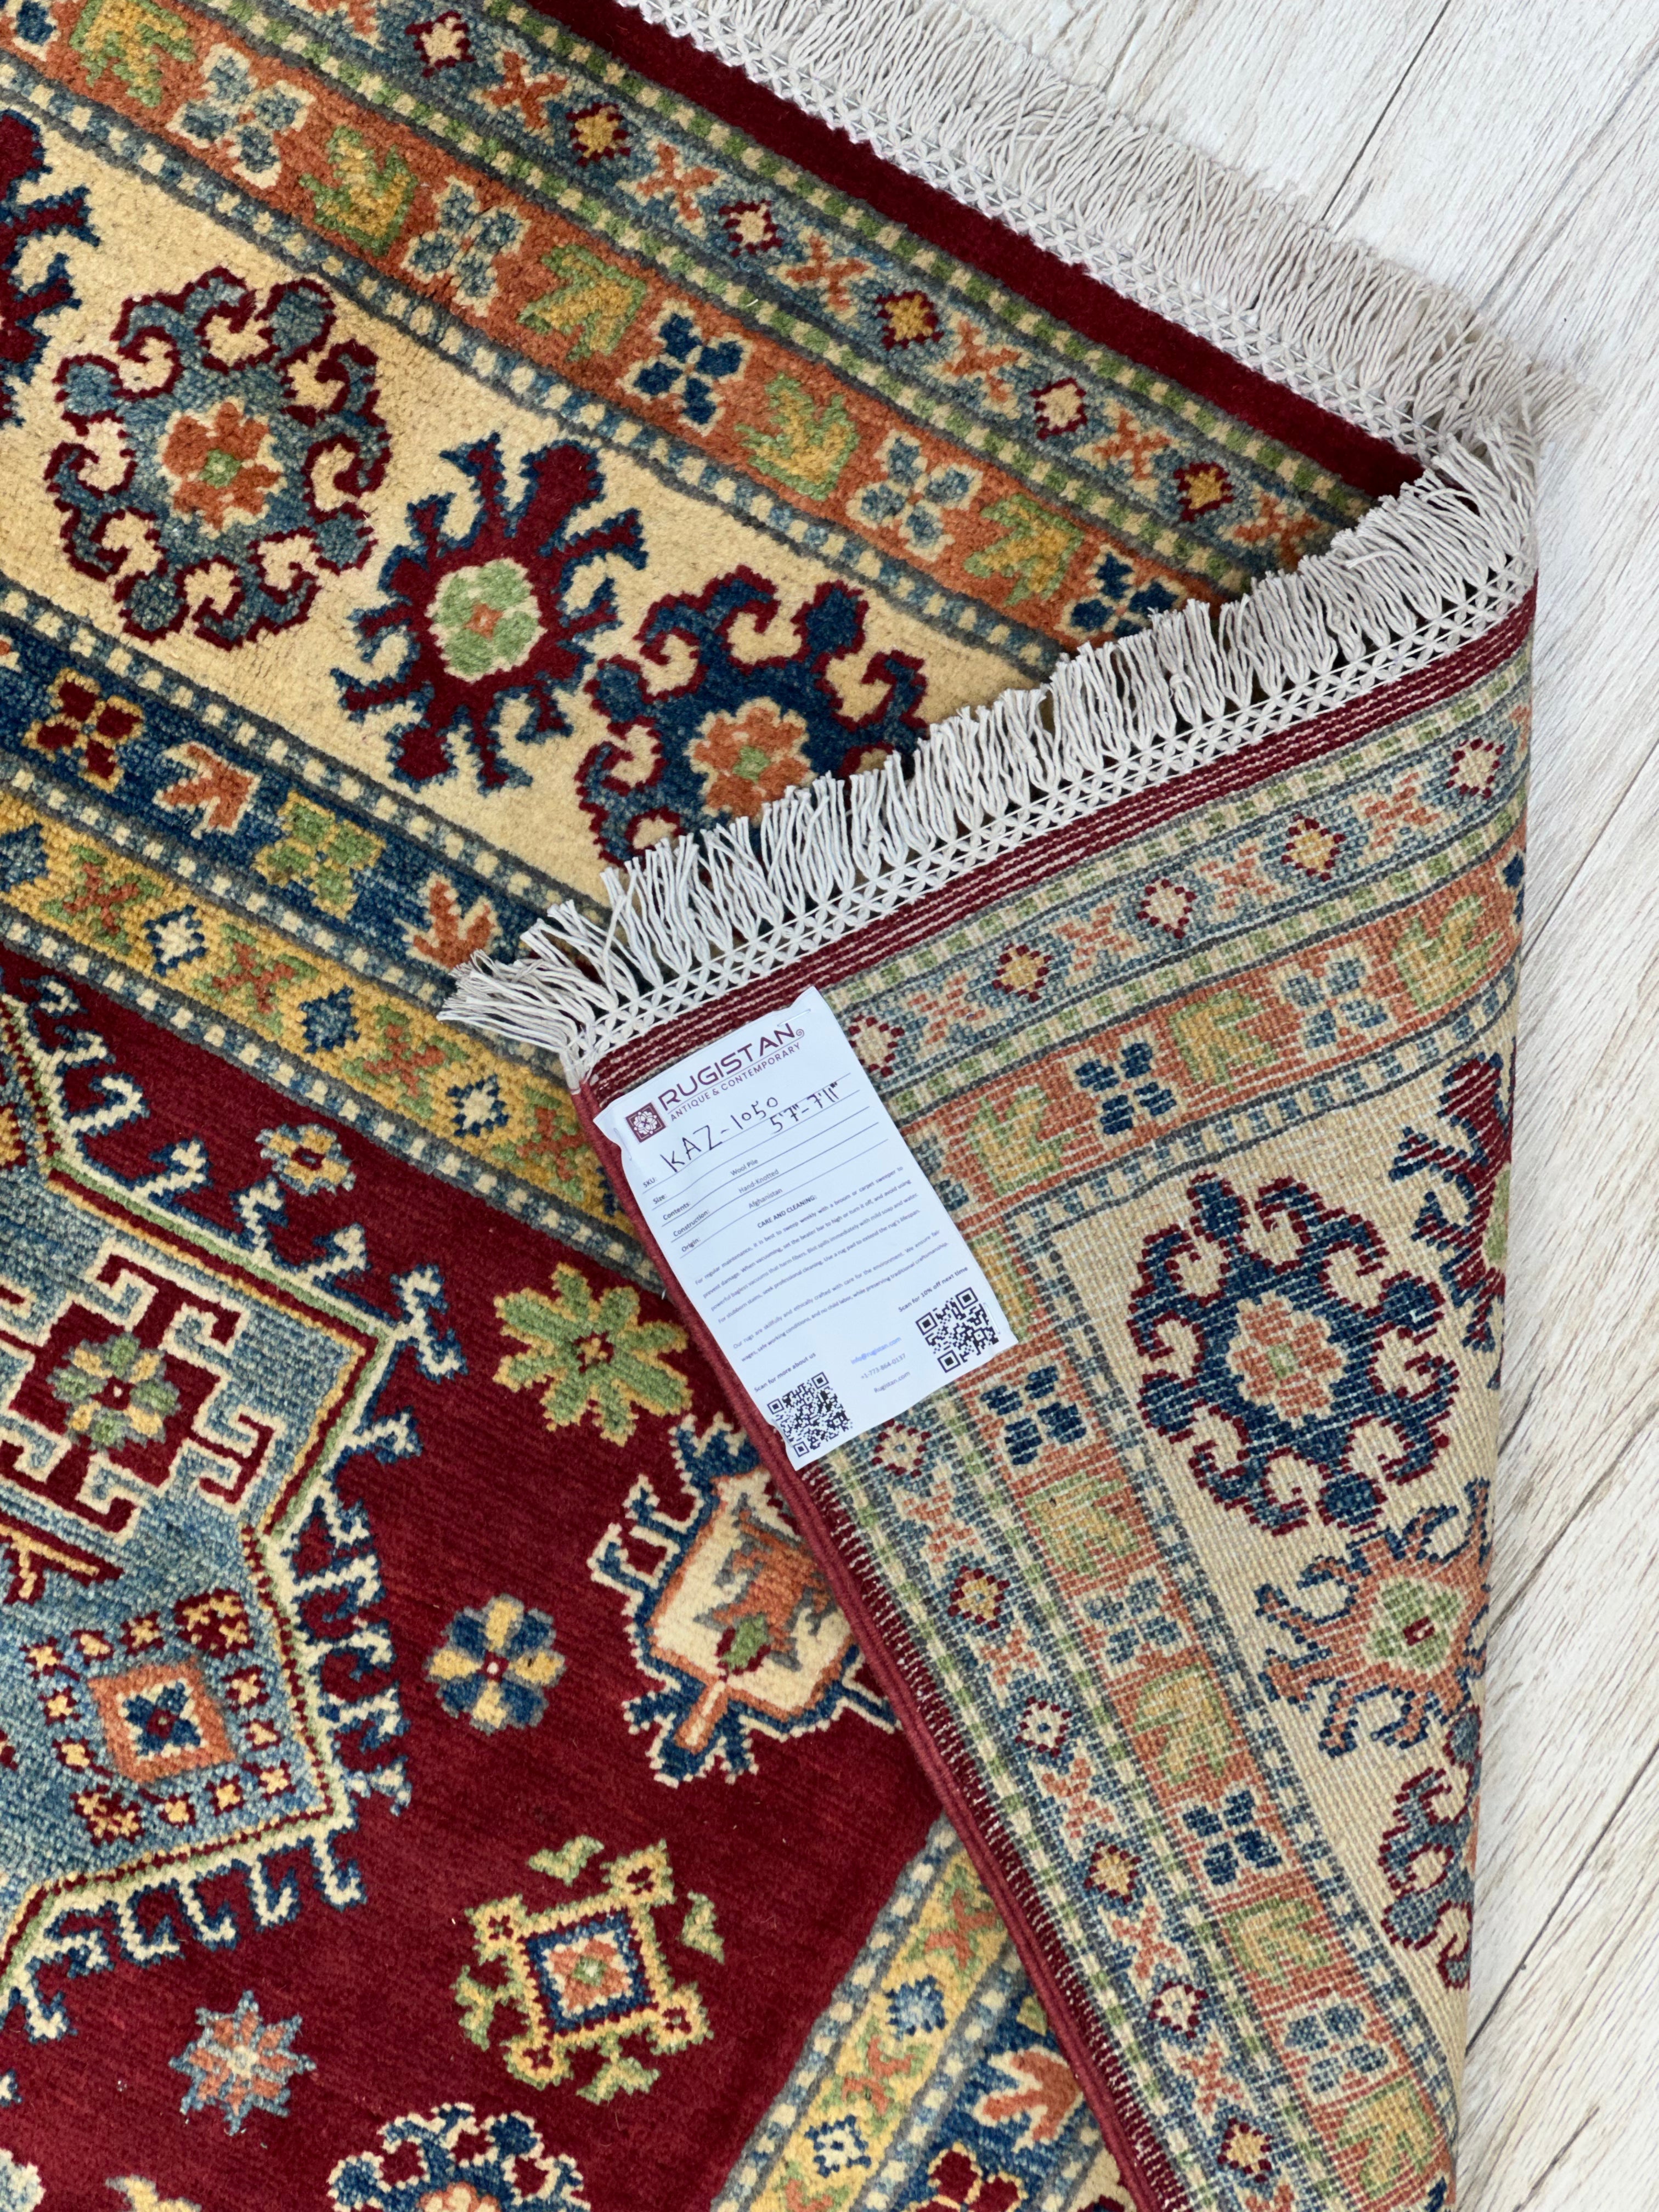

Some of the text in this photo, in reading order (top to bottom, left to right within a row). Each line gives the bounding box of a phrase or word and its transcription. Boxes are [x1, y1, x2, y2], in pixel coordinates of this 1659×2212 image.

[657, 1023, 795, 1111] RUGISTAN
[670, 1042, 800, 1122] ANTIQUE & CONTEMPORARY
[642, 1177, 656, 1188] SKU:
[652, 1194, 665, 1205] Size:
[662, 1159, 759, 1221] Contents: Wool Pile
[673, 1168, 780, 1237] Construction: Hand-Knotted
[757, 1195, 816, 1228] CARE AND CLEANING:
[681, 1188, 783, 1252] Origin: Afghanistan
[695, 1277, 703, 1285] For
[704, 1266, 720, 1279] regular
[721, 1247, 753, 1268] maintenance,
[763, 1233, 776, 1242] best
[782, 1221, 799, 1232] sweep
[799, 1212, 817, 1223] weekly
[833, 1194, 851, 1206] broom
[859, 1181, 875, 1193] carpet
[875, 1170, 896, 1183] sweeper
[702, 1284, 721, 1299] prevent
[720, 1272, 740, 1286] damage.
[740, 1262, 756, 1273] When
[755, 1247, 783, 1264] vacuuming,
[799, 1229, 816, 1240] beater
[831, 1216, 843, 1224] high
[848, 1206, 861, 1215] turn
[873, 1193, 884, 1202] and
[884, 1186, 898, 1197] avoid
[897, 1179, 912, 1189] using
[710, 1193, 918, 1312] powerful bagless vacuums that harm fibers. Blot spills immediately with mild soap and water.
[726, 1302, 748, 1319] stubborn
[747, 1294, 763, 1305] stains,
[762, 1286, 774, 1295] seek
[773, 1269, 803, 1289] professional
[802, 1260, 824, 1273] cleaning.
[846, 1242, 857, 1251] pad
[861, 1229, 879, 1242] extend
[887, 1220, 901, 1229] rug's
[899, 1209, 921, 1222] lifespan.
[732, 1341, 743, 1350] Our
[743, 1334, 754, 1342] rugs
[783, 1308, 793, 1318] and
[793, 1298, 814, 1312] ethically
[814, 1288, 832, 1301] crafted
[831, 1283, 844, 1291] with
[843, 1277, 855, 1285] care
[872, 1252, 905, 1271] environment.
[915, 1235, 931, 1248] ensure
[741, 1351, 758, 1362] wages,
[757, 1344, 768, 1352] safe
[767, 1331, 787, 1346] working
[785, 1317, 812, 1334] conditions,
[811, 1310, 821, 1319] and
[827, 1301, 840, 1311] child
[838, 1295, 853, 1305] labor,
[852, 1289, 866, 1297] while
[865, 1276, 891, 1292] preserving
[889, 1261, 916, 1279] traditional
[915, 1242, 949, 1265] craftsmanship.
[898, 1267, 968, 1313] Scan for 10% off next time
[754, 1383, 768, 1393] Scan
[768, 1376, 776, 1385] for
[776, 1367, 792, 1379] more
[792, 1356, 809, 1370] about
[850, 1336, 902, 1365] info@rugistan.com
[861, 1352, 906, 1379] +1-773-864-0137
[873, 1371, 911, 1393] Rugistan.com
